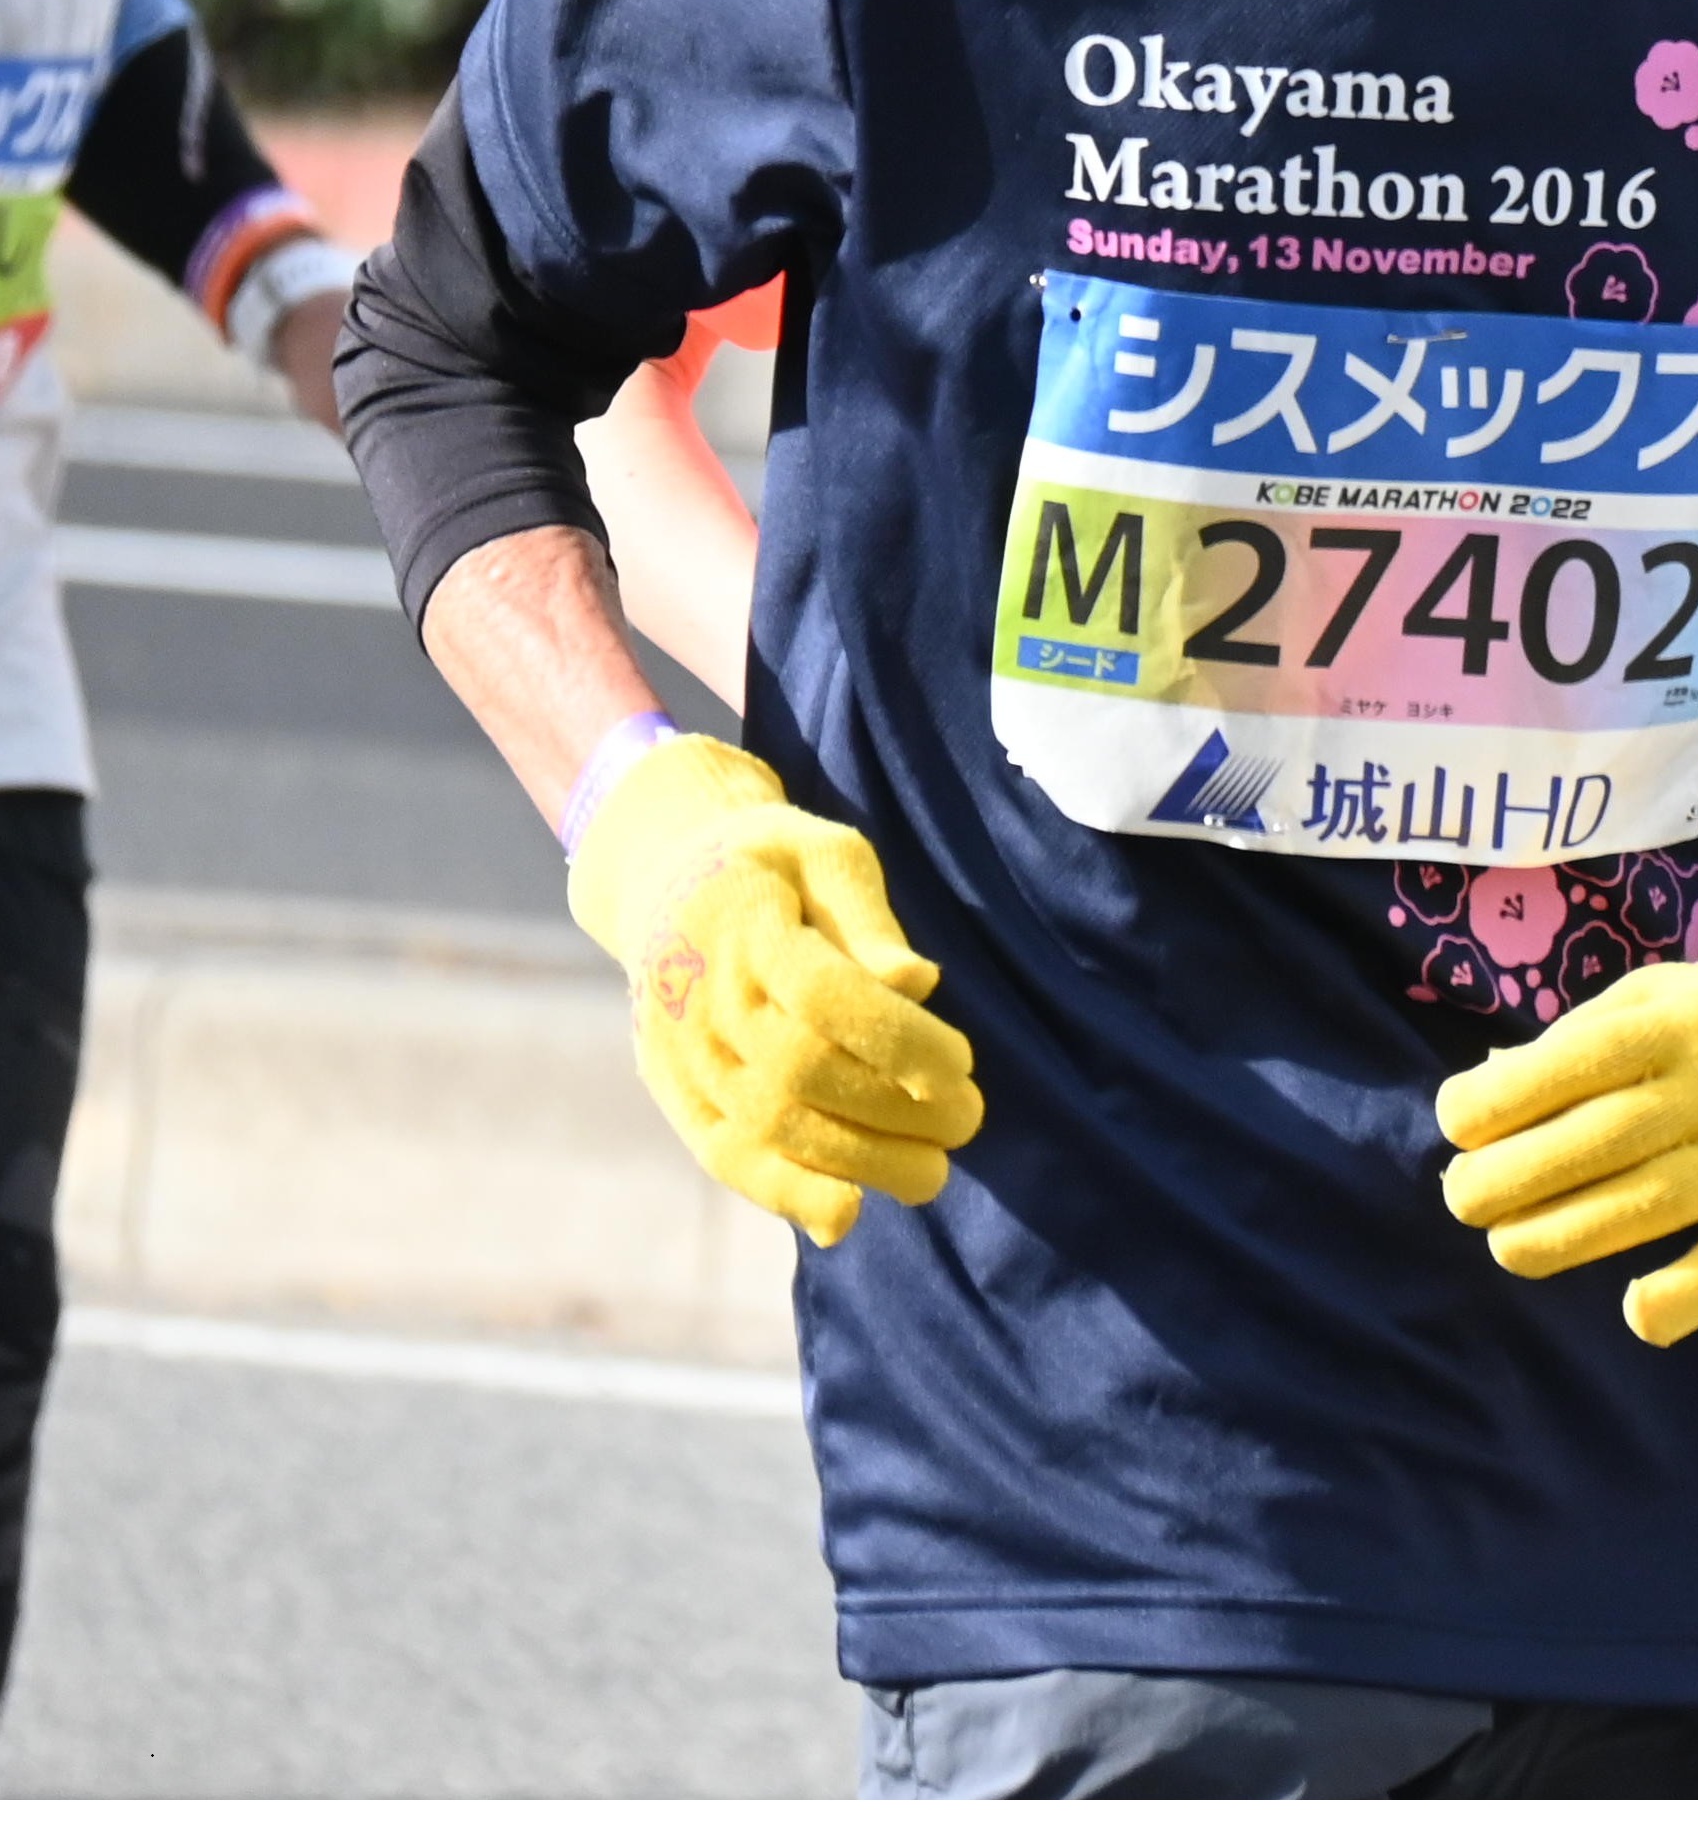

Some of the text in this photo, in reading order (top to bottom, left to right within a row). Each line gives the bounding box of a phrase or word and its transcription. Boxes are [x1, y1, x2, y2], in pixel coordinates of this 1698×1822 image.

[1064, 34, 1454, 137] Okayama
[1064, 132, 1657, 230] Marathon 2016
[1066, 218, 1535, 279] Sunday, 13 November
[1256, 482, 1592, 521] KOBE MARATHON 2022
[1022, 500, 1147, 636] M
[1039, 642, 1116, 678] シード
[1303, 762, 1611, 852] 城山HD
